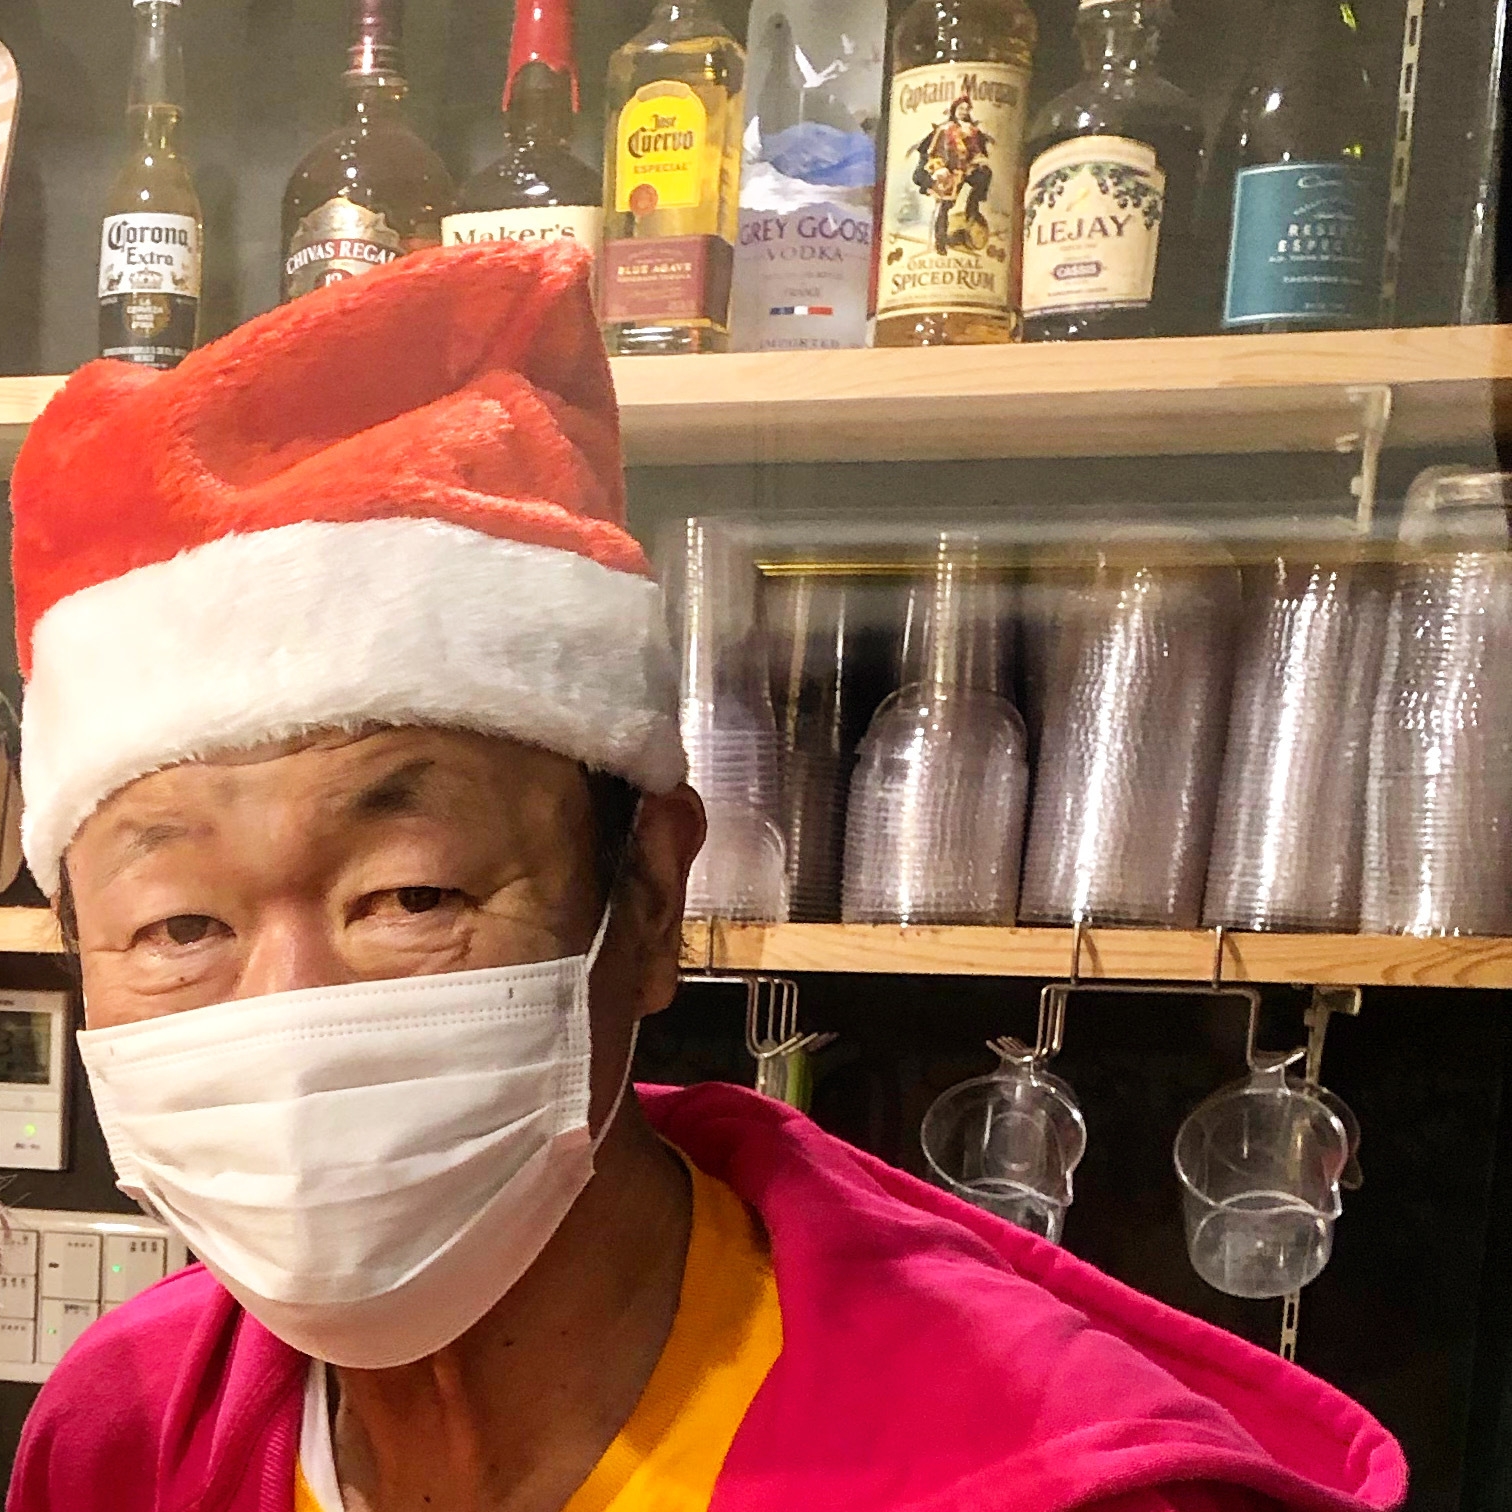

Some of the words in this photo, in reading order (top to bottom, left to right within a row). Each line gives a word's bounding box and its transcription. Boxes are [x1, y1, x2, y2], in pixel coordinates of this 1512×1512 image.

[899, 77, 955, 114] Captain
[628, 127, 694, 158] Cuervo
[634, 162, 689, 175] ESPECIAL
[108, 220, 189, 251] Corona
[452, 223, 576, 245] Maker's
[740, 218, 787, 246] GREY
[1036, 214, 1133, 246] LEJAY
[126, 247, 174, 266] Extra
[286, 241, 335, 275] CHIVAS
[907, 257, 984, 271] ORIGINAL
[891, 270, 955, 295] SPICED
